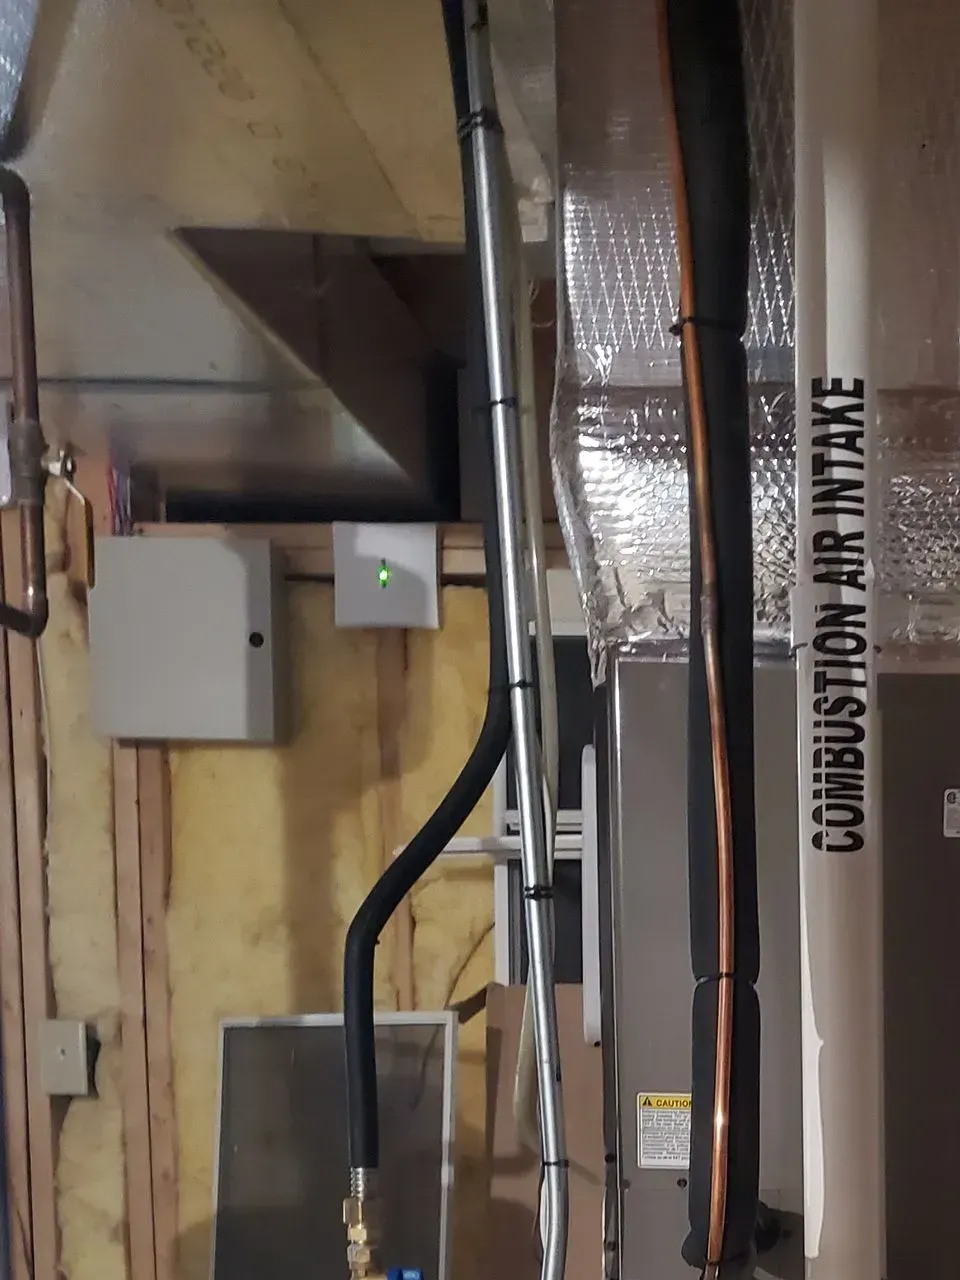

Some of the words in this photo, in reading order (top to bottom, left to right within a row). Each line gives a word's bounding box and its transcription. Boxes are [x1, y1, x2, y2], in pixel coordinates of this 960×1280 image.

[811, 376, 866, 518] INTAKE
[811, 532, 868, 592] AIR
[811, 603, 868, 853] COMBUSTION
